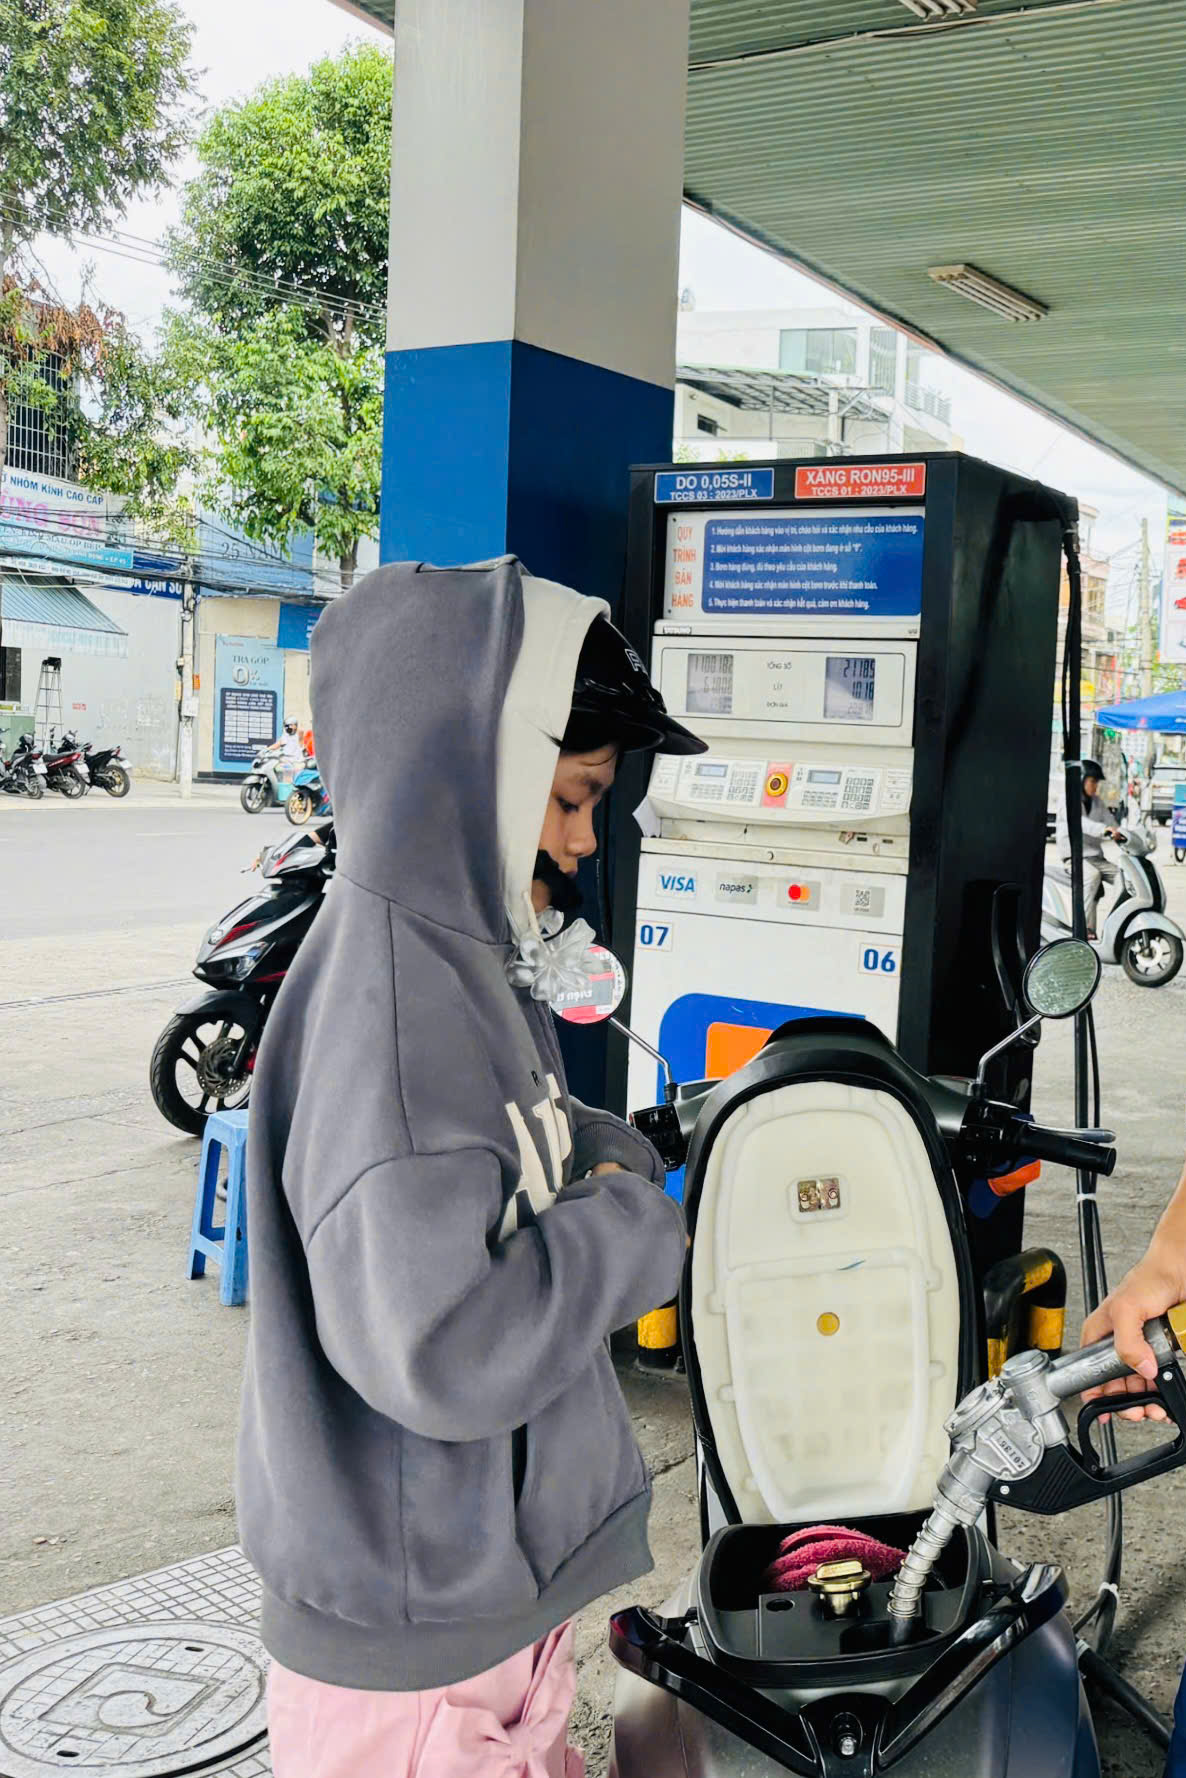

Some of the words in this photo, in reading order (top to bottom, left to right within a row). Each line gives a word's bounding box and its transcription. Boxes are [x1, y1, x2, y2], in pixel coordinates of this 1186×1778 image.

[676, 476, 697, 490] DO
[701, 473, 752, 490] 0,05S-II
[806, 467, 846, 485] XĂNG
[850, 467, 915, 484] RON95-III
[670, 491, 695, 501] TCCS
[696, 491, 708, 500] 03
[715, 488, 757, 499] 2023/PLX
[811, 486, 838, 497] TCCS
[840, 486, 852, 496] 01
[862, 484, 907, 496] 2023/PLX
[660, 874, 695, 893] VISA
[719, 882, 745, 894] napas
[640, 924, 669, 947] 07
[863, 948, 896, 972] 06
